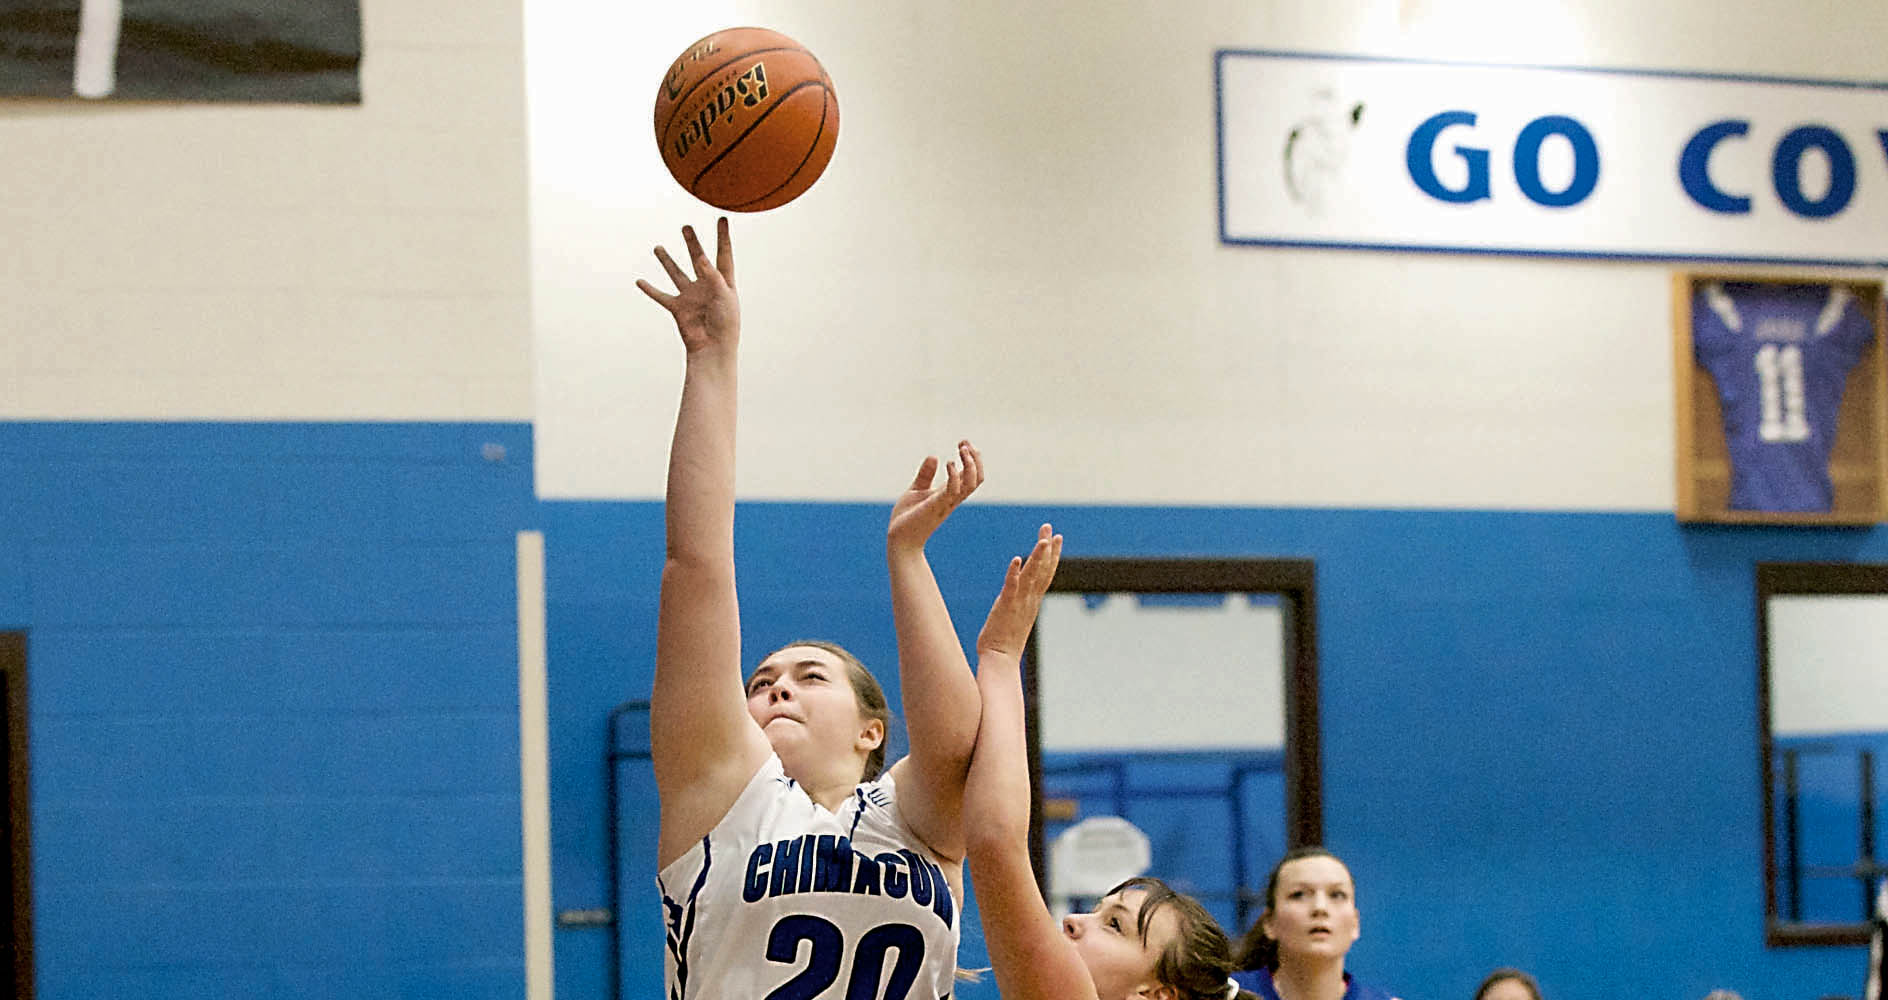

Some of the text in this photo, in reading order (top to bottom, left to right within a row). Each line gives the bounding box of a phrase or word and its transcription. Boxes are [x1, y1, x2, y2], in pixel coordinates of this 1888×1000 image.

[674, 61, 769, 160] Baden
[1405, 110, 1888, 219] GO CO
[1755, 342, 1811, 443] 11
